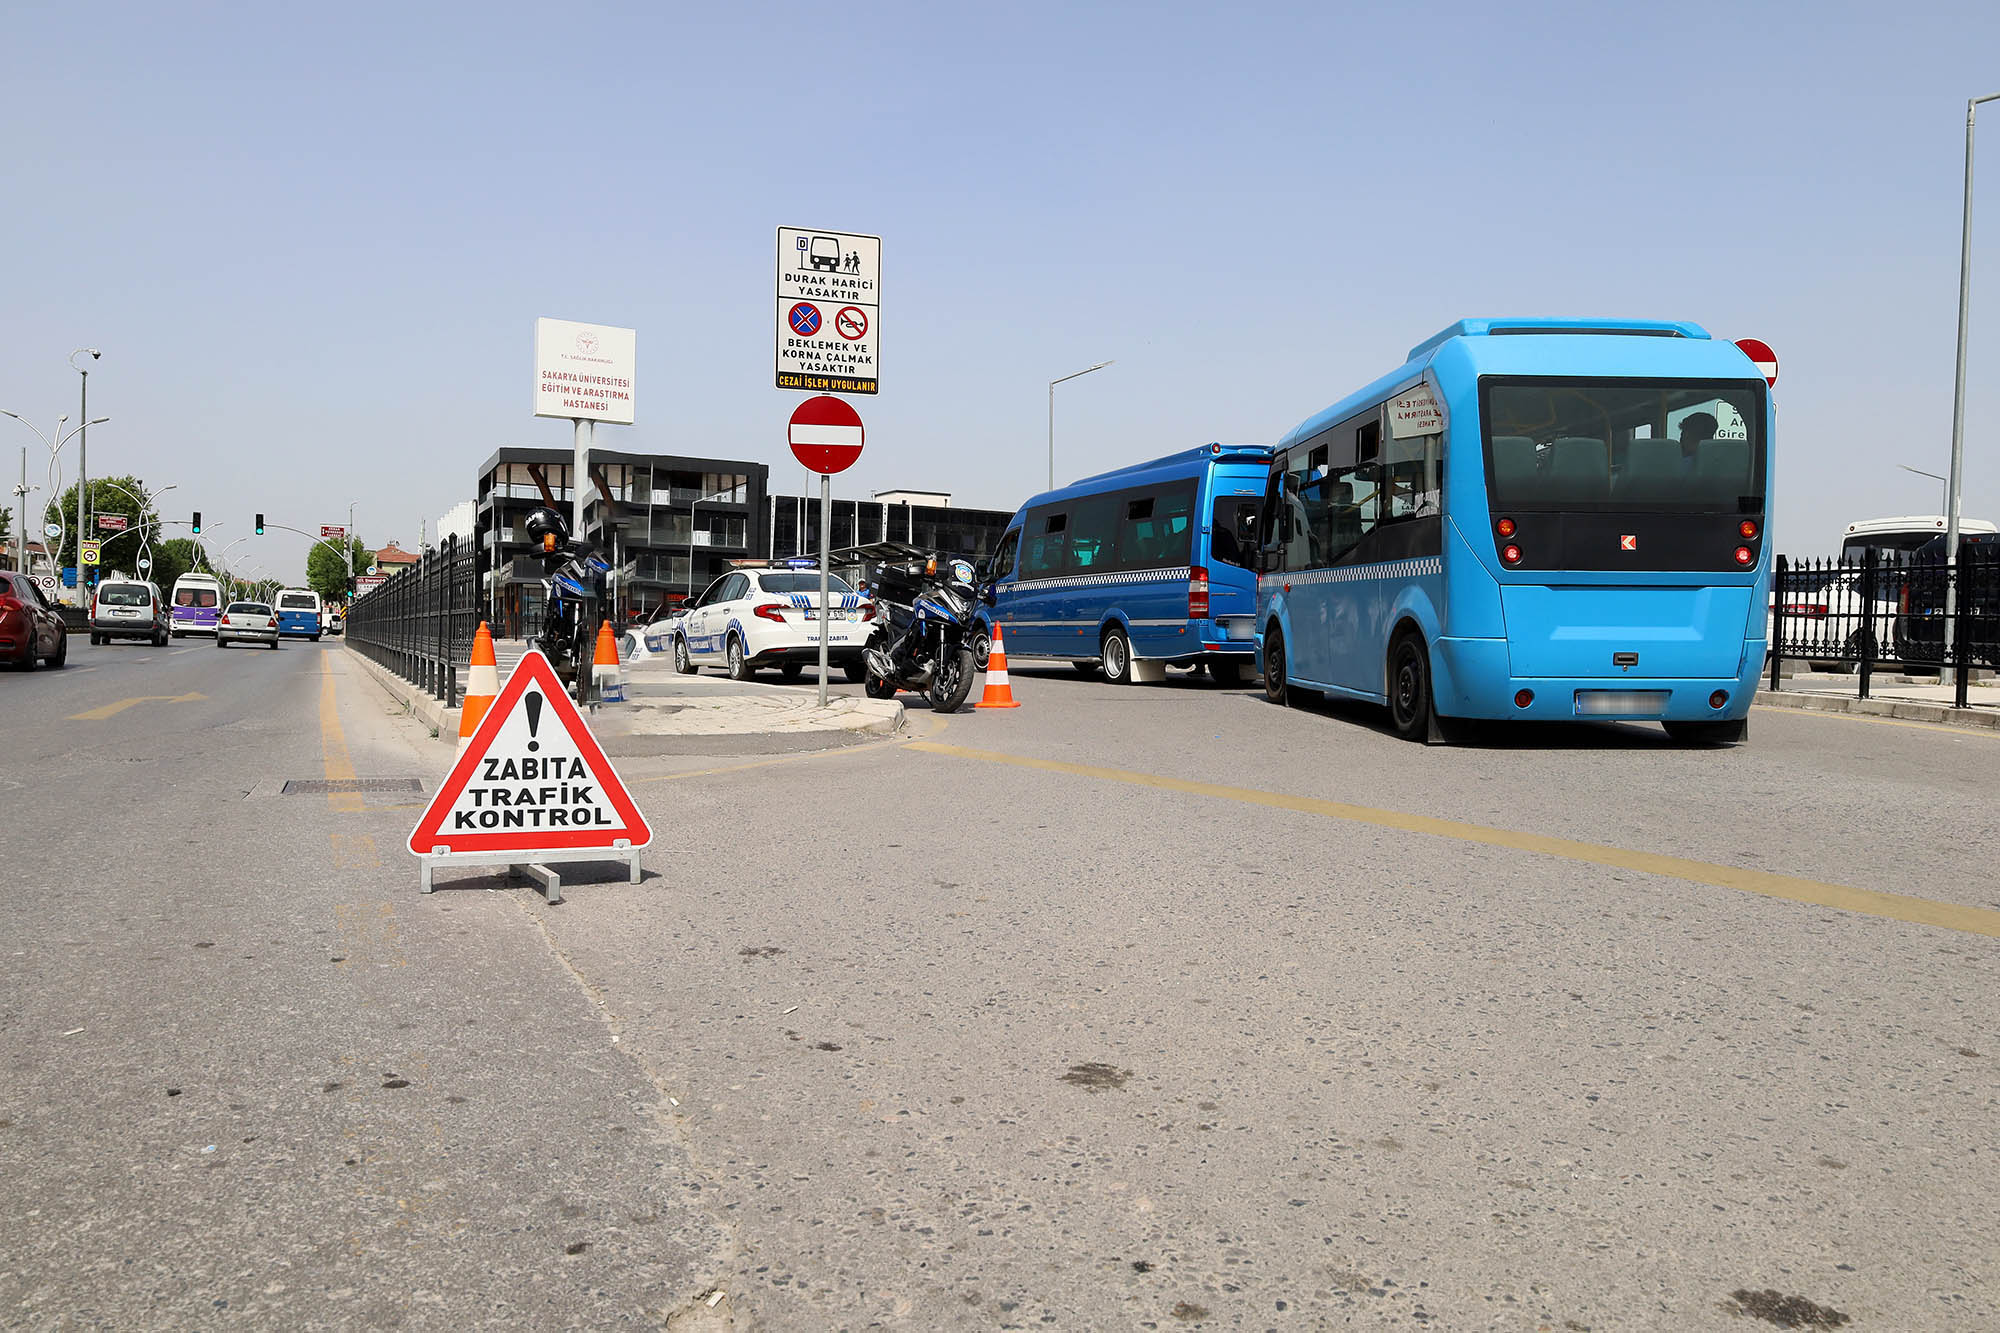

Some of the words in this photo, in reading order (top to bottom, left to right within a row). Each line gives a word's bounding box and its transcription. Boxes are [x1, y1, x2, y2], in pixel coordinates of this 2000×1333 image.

[799, 239, 806, 248] D
[785, 273, 826, 285] DURAK
[832, 277, 873, 290] HARİCİ
[798, 286, 859, 300] YASAKTIR
[788, 338, 849, 351] BEKLEMEK
[854, 344, 867, 353] VE
[782, 349, 821, 361] KORNA
[826, 352, 872, 364] ÇALMAK
[799, 361, 855, 374] YASAKTIR
[542, 370, 577, 382] SAKARYA
[578, 372, 630, 388] ÜNİVERSİTESİ
[779, 374, 802, 387] CEZAİ
[804, 374, 829, 389] İŞLEM
[831, 377, 876, 392] UYGULANIR
[541, 381, 570, 394] EĞİTİM
[571, 386, 582, 396] VE
[563, 399, 609, 411] HASTANESİ
[1730, 417, 1744, 427] Ar
[1718, 429, 1745, 439] Gire
[483, 757, 587, 781] ZABITA
[468, 782, 593, 807] TRAFİK
[455, 807, 612, 829] KONTROL
